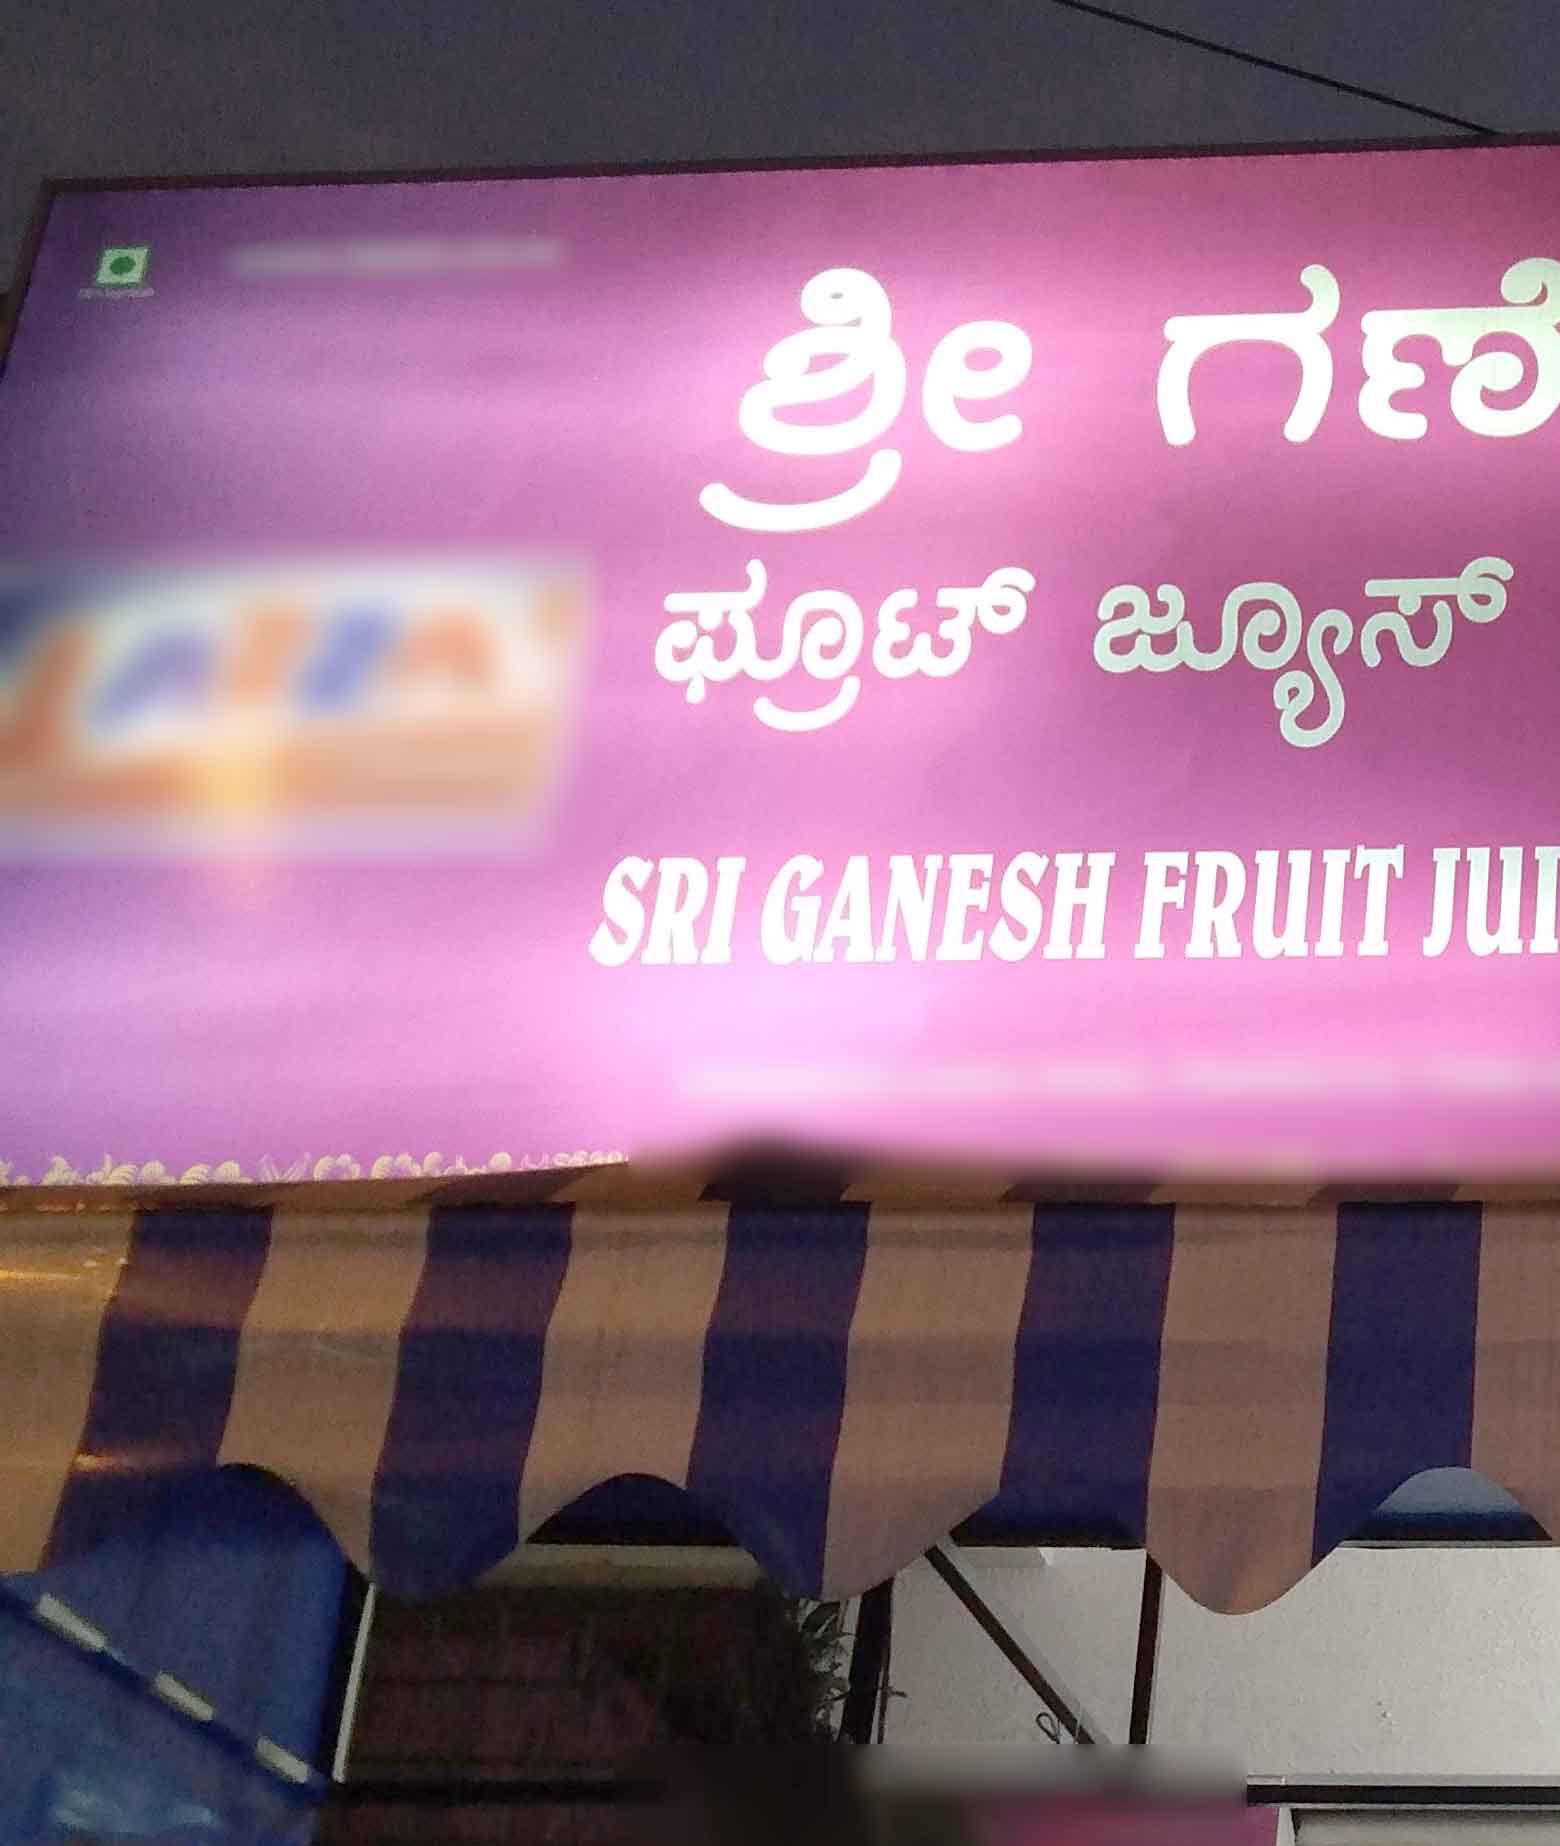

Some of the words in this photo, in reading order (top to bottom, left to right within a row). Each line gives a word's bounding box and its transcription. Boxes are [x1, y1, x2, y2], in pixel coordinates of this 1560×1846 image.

[700, 267, 1033, 531] ಶ್ರೀ
[589, 856, 746, 966] SRI
[760, 851, 1116, 963] GANESH
[1134, 844, 1404, 961] FRUIT
